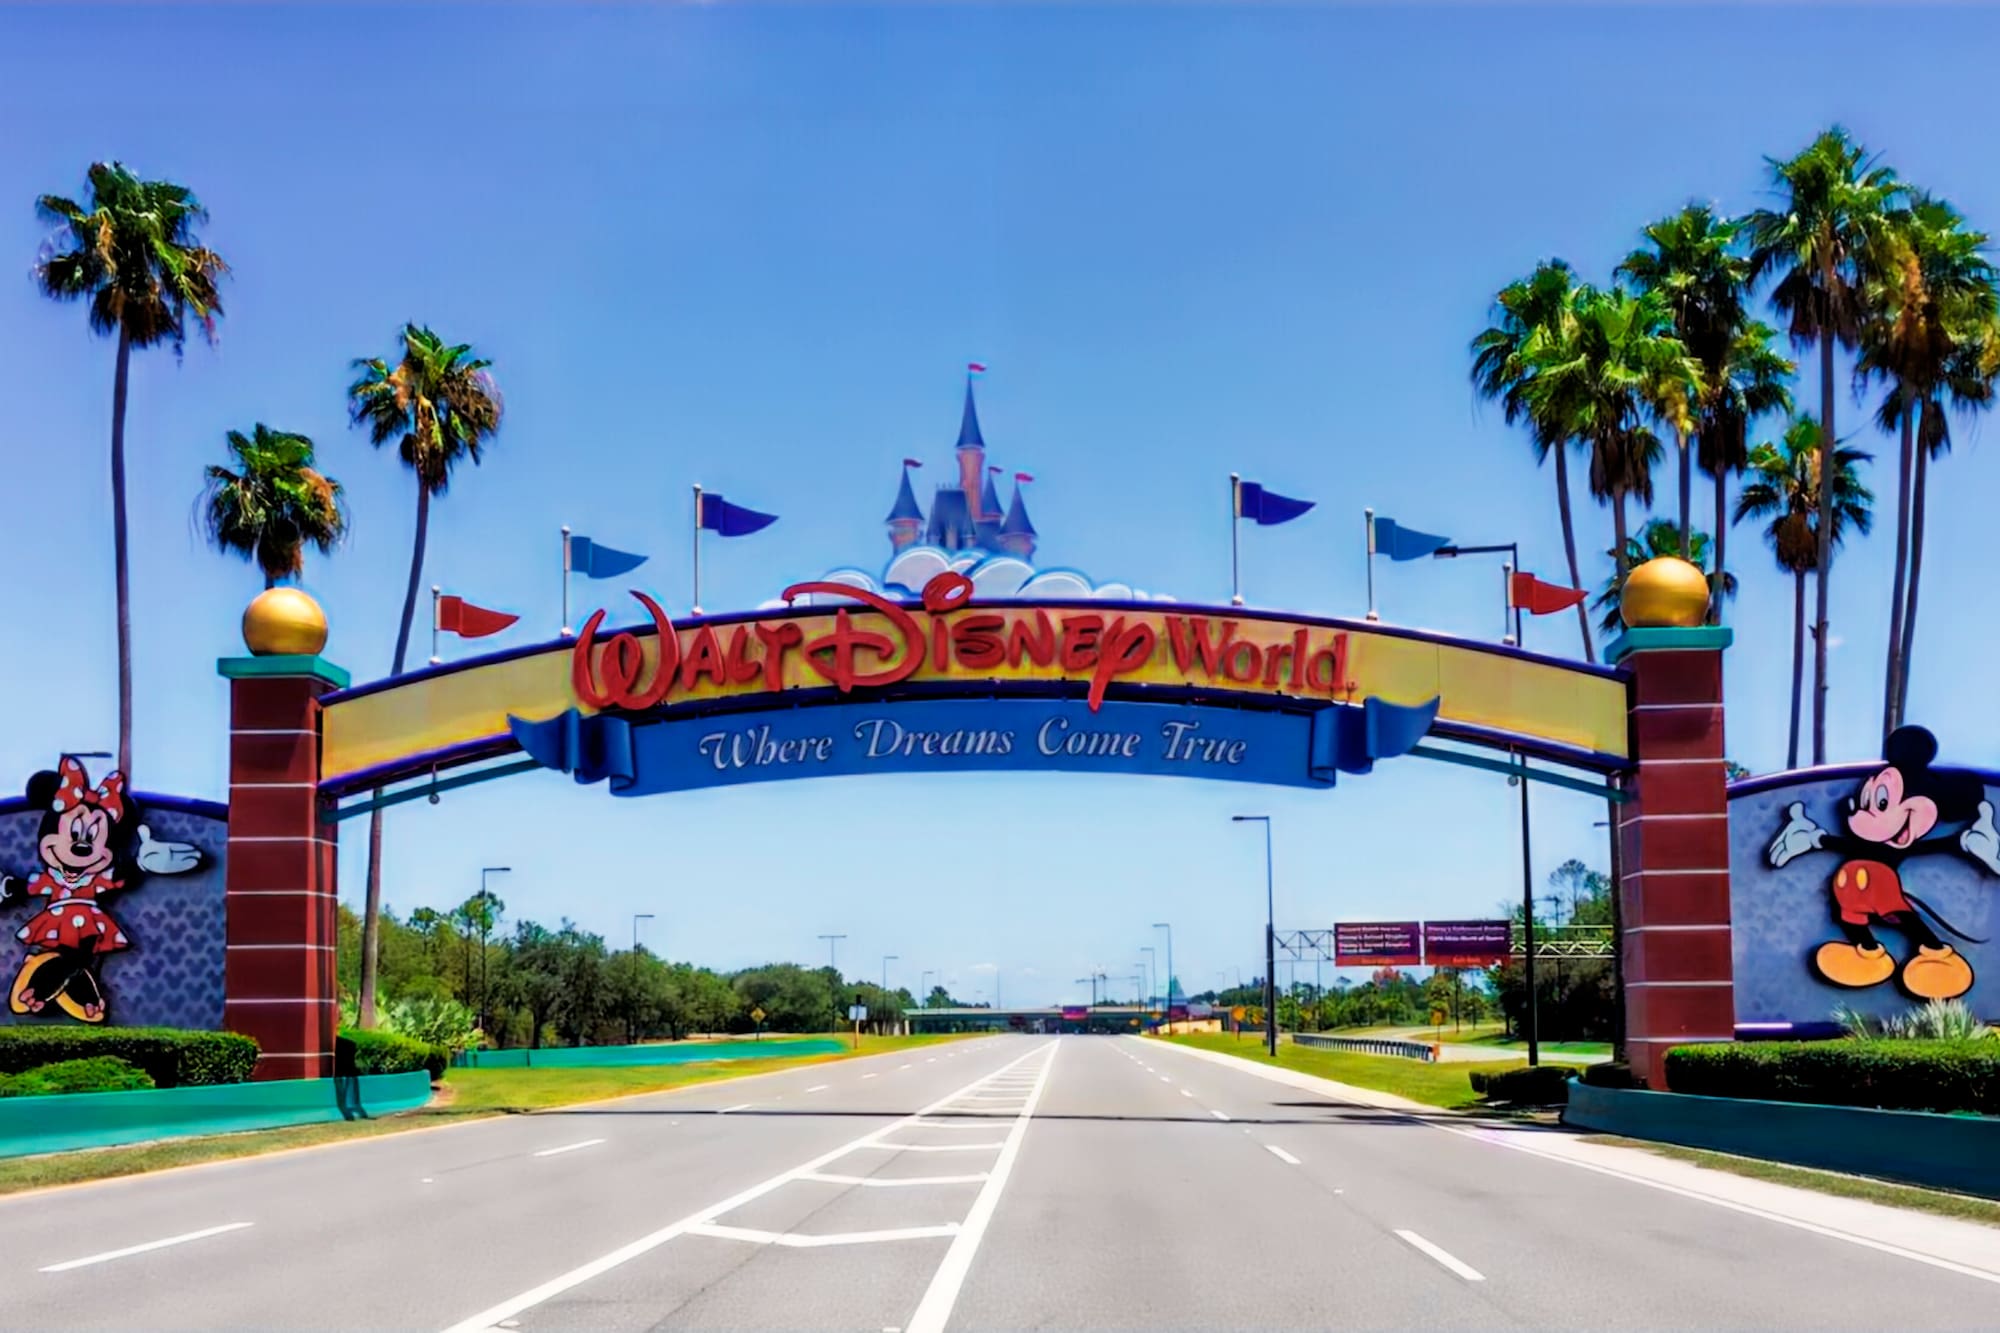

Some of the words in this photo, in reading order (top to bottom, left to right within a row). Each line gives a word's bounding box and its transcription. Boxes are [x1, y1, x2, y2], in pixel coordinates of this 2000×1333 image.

[1164, 616, 1348, 691] World
[699, 726, 833, 770] Where
[855, 719, 1015, 758] Dreams
[1037, 717, 1141, 757] Come
[1161, 721, 1247, 764] True
